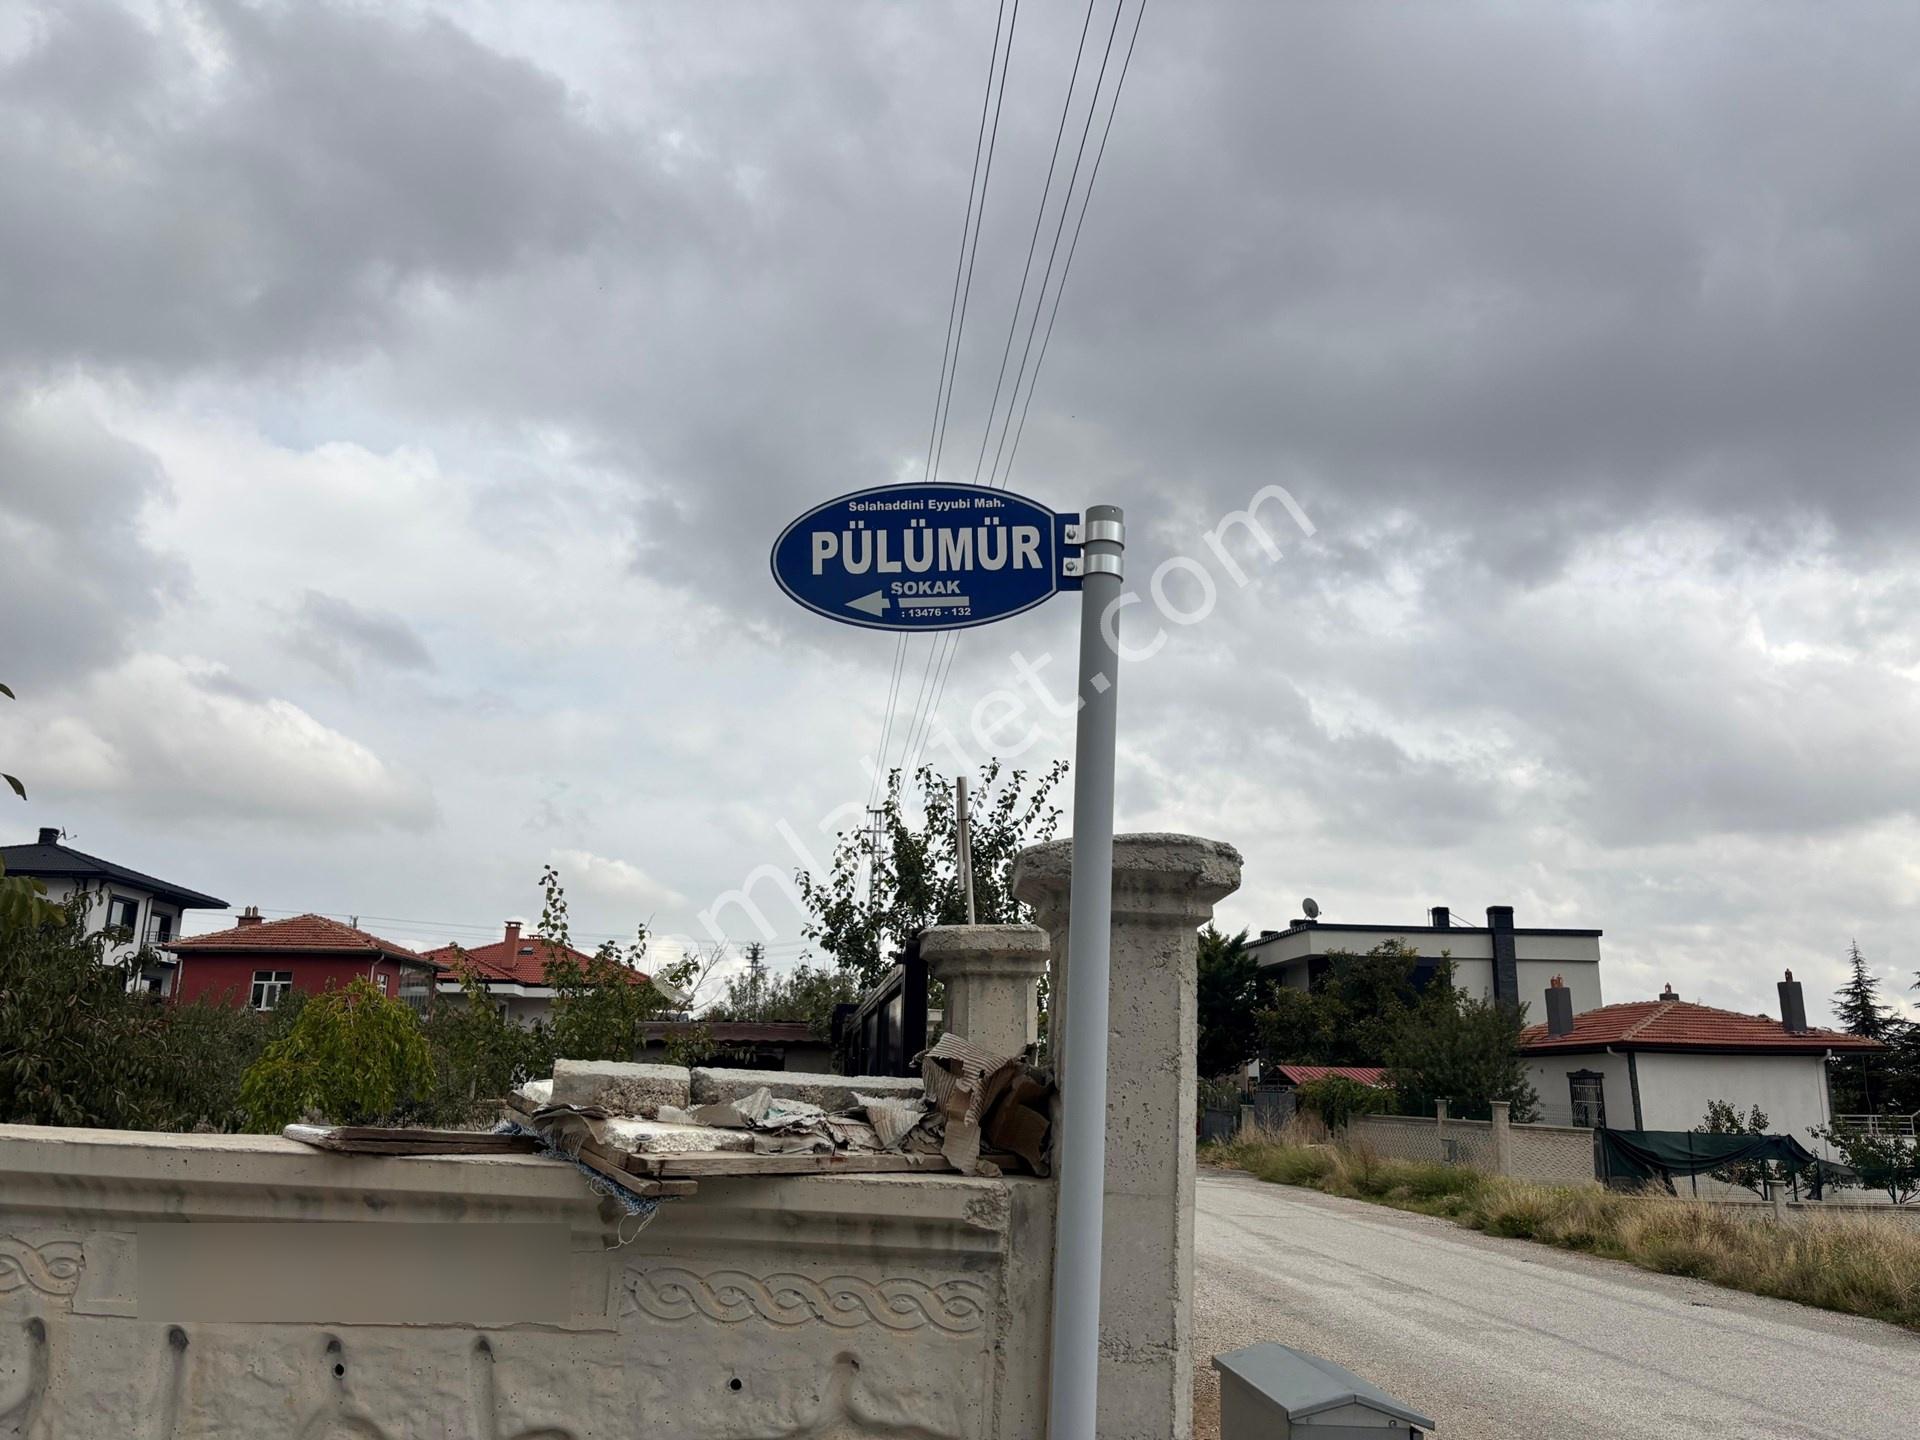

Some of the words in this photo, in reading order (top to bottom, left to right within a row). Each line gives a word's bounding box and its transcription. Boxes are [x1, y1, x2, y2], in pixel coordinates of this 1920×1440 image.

[849, 500, 924, 511] Selahaddini
[928, 499, 970, 511] Eyyubi
[974, 498, 1005, 509] Mah.
[812, 517, 1043, 576] PÜLÜMÜR
[891, 580, 960, 595] SOKAK
[908, 608, 942, 617] 13476
[951, 607, 971, 616] 132
